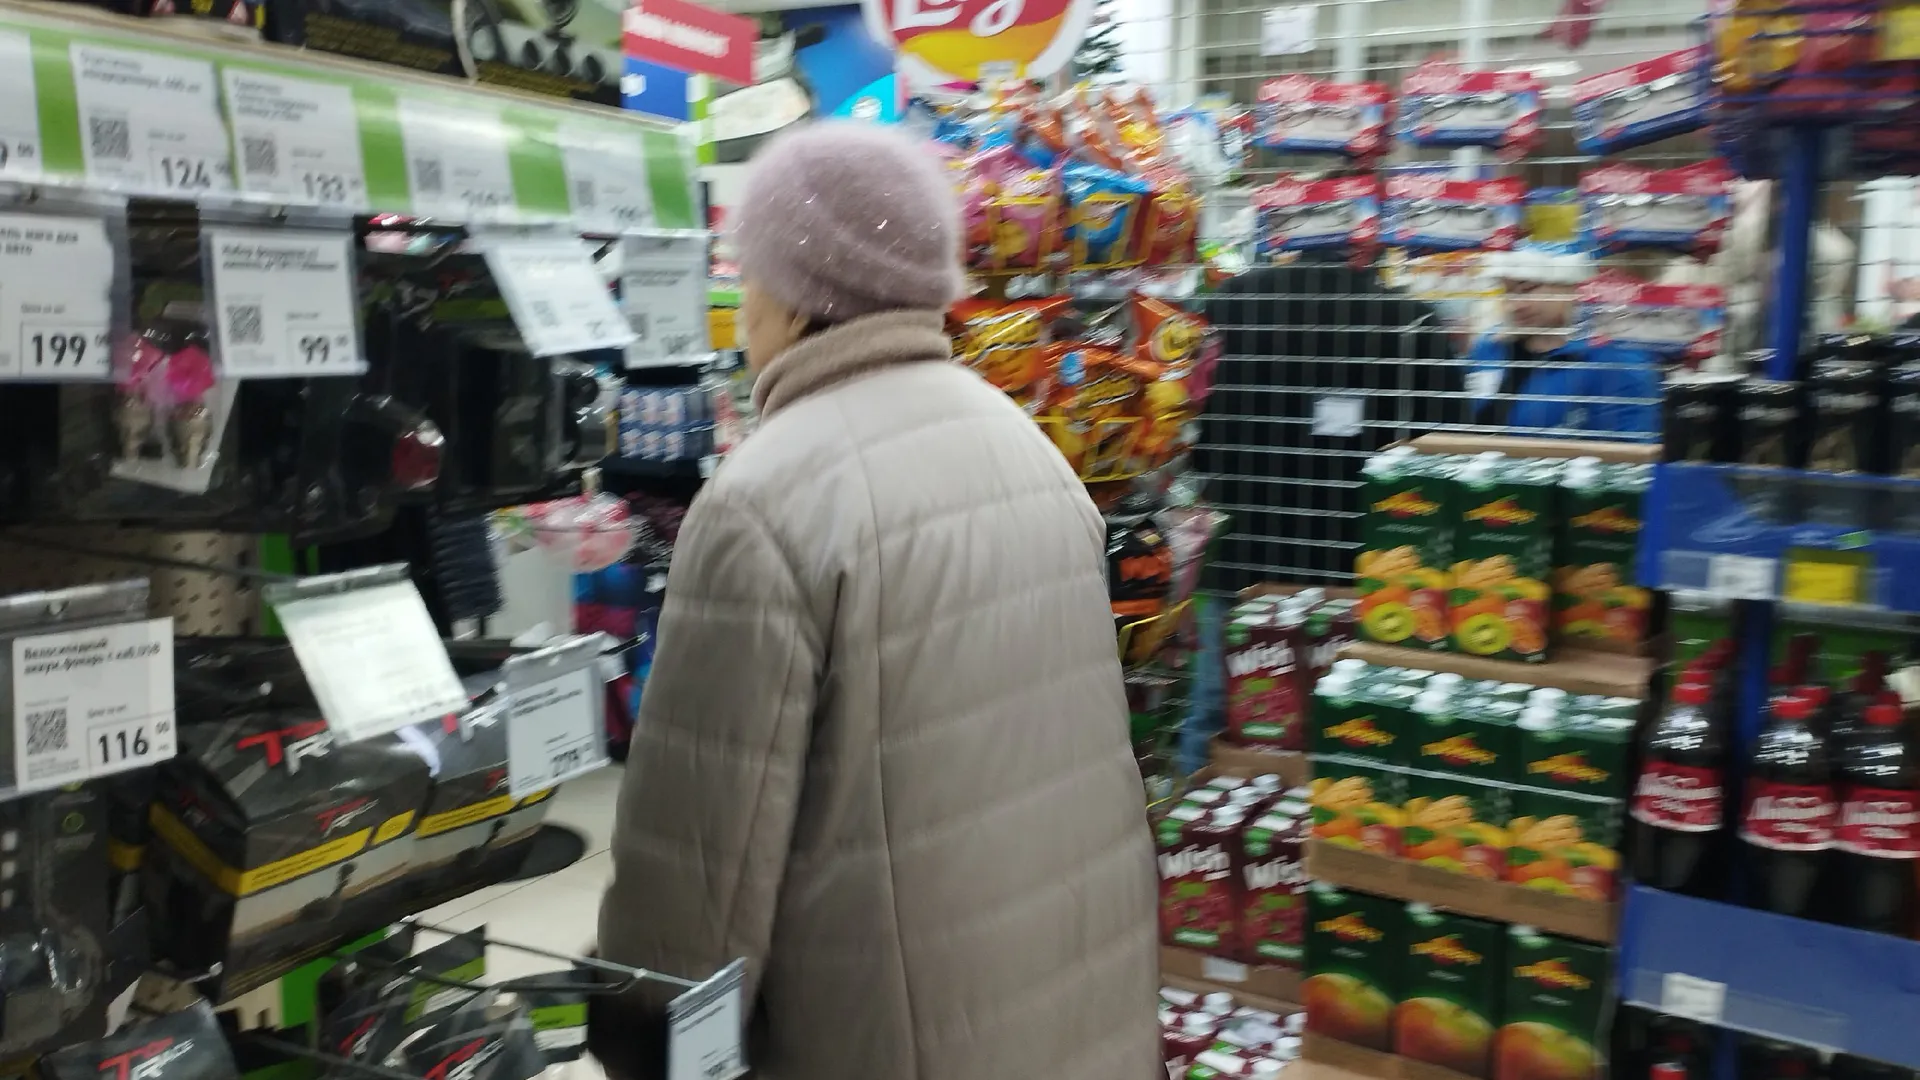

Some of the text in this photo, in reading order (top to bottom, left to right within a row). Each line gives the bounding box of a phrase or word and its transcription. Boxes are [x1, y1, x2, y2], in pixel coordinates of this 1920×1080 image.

[160, 156, 211, 189] 124
[31, 331, 87, 368] 199
[299, 335, 330, 365] 99
[98, 726, 149, 764] 116
